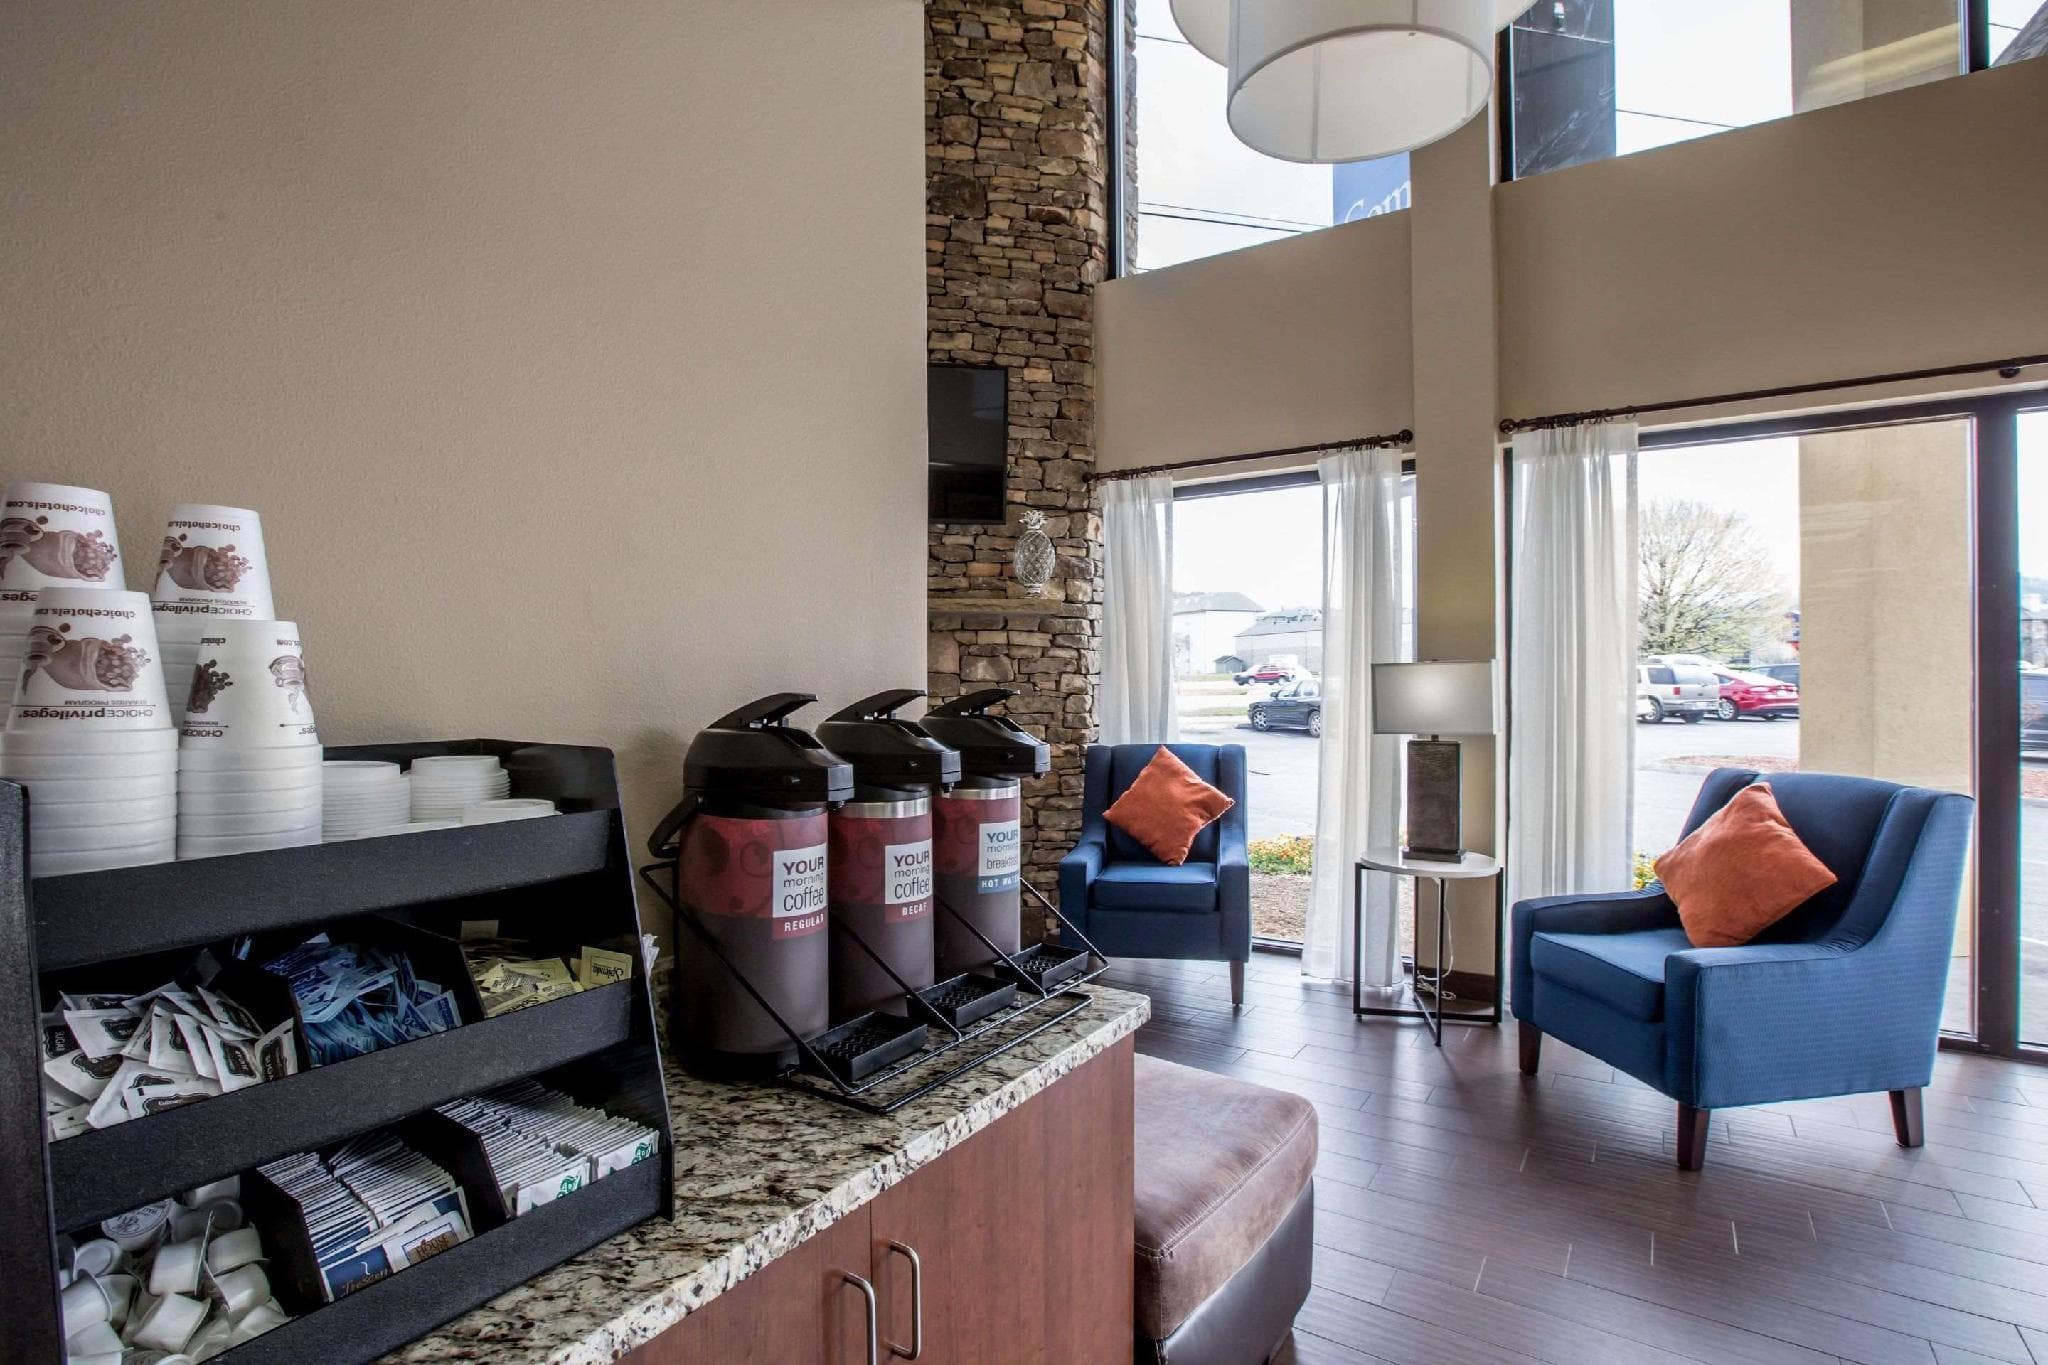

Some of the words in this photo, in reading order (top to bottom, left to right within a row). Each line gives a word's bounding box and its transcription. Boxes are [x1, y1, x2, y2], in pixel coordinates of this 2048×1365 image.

[782, 856, 824, 876] YOUR
[893, 850, 929, 868] YOUR
[783, 872, 824, 888] morning
[894, 876, 930, 900] coffee
[981, 878, 999, 888] HOT
[783, 885, 824, 912] coffee
[902, 902, 928, 917] DECAF
